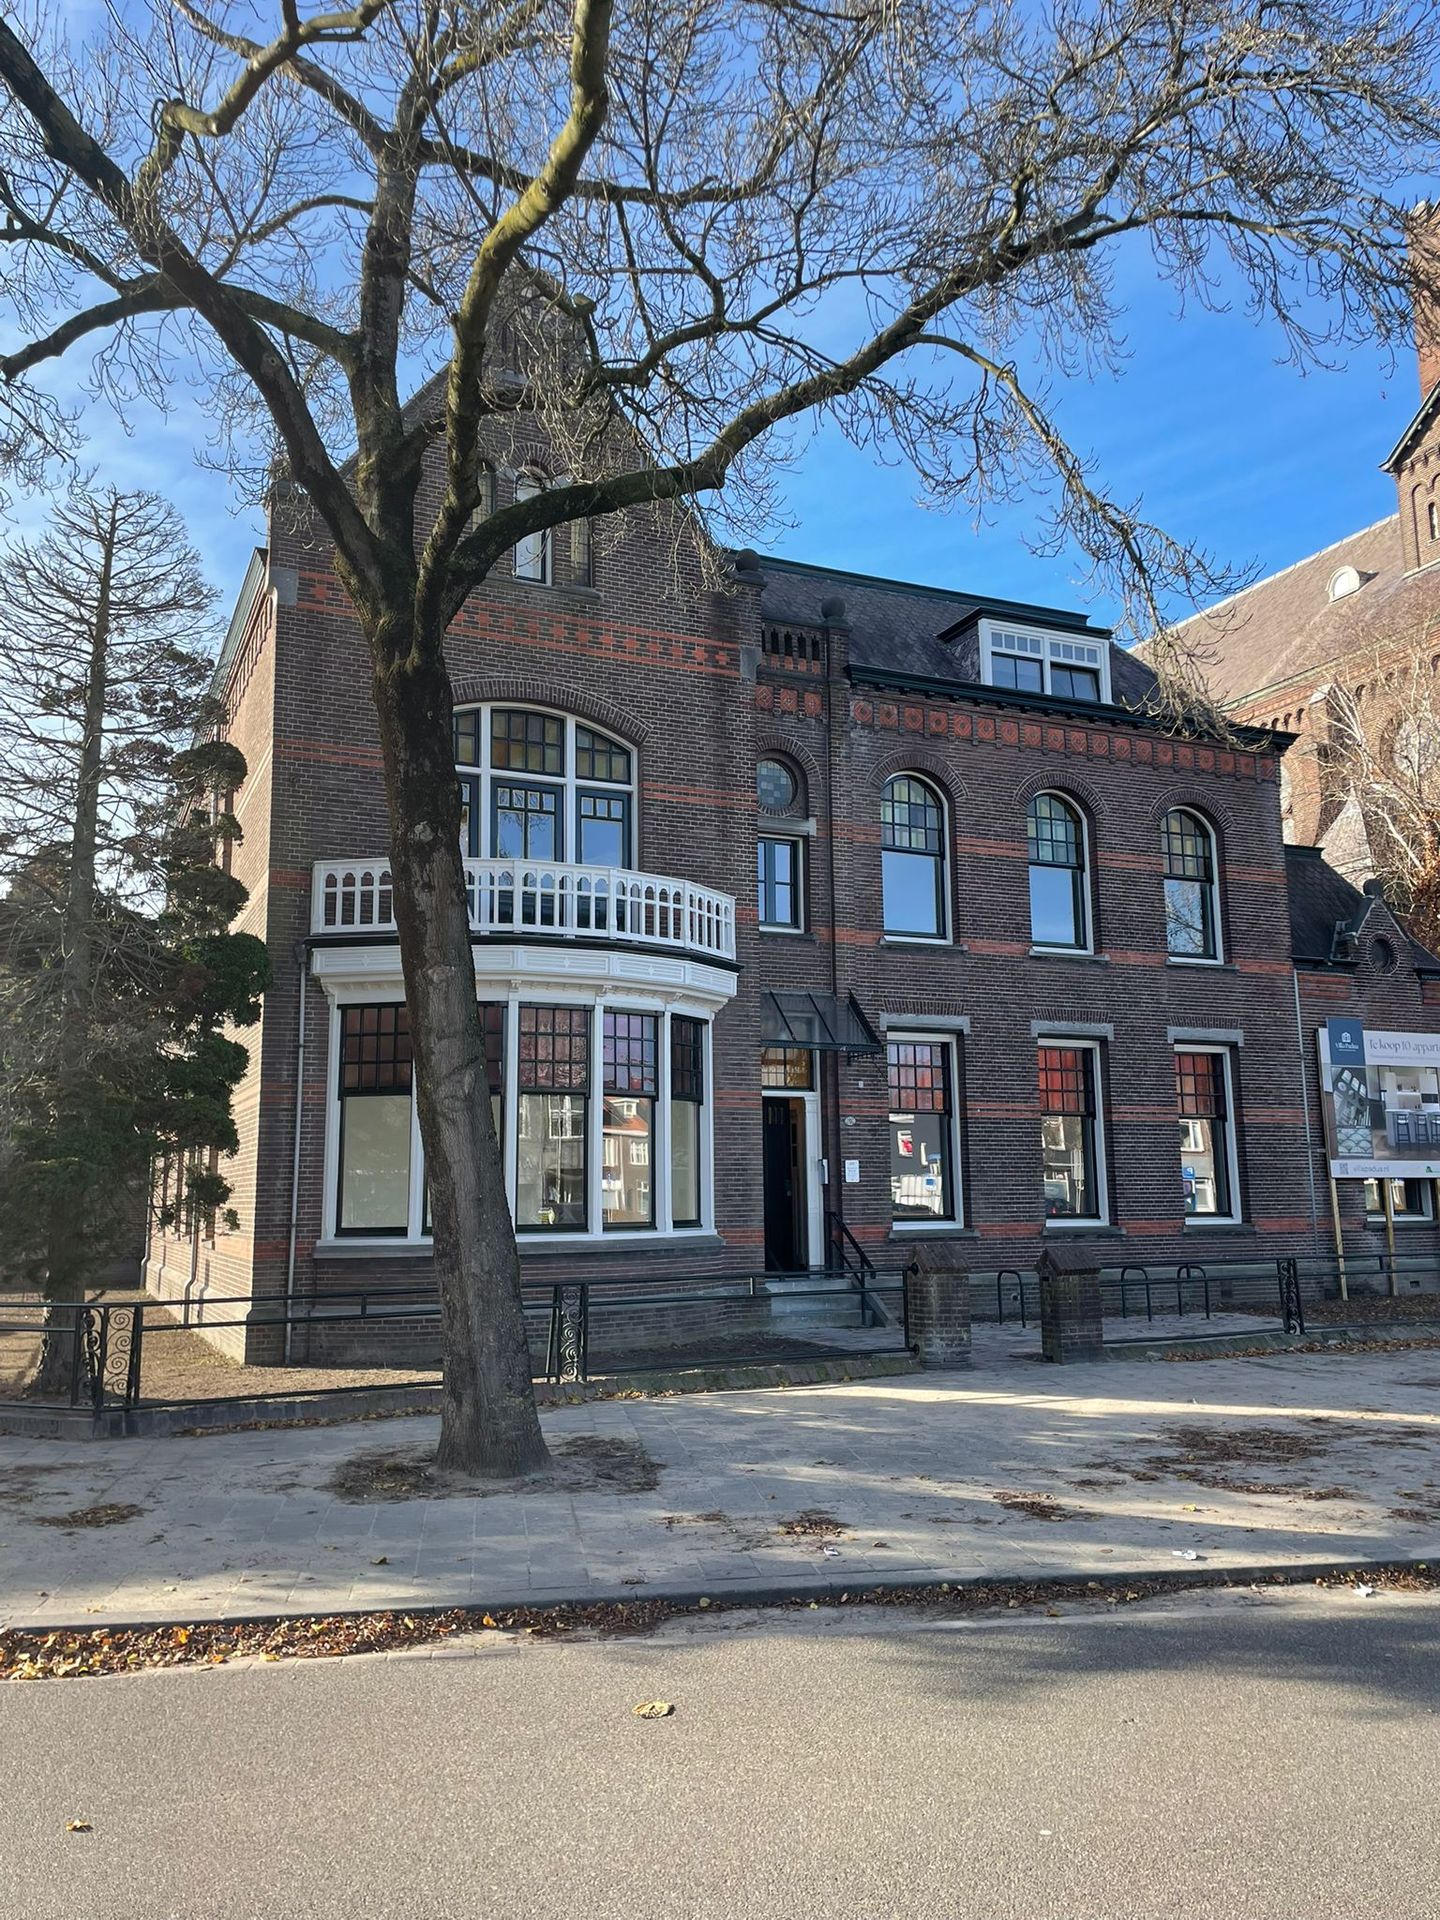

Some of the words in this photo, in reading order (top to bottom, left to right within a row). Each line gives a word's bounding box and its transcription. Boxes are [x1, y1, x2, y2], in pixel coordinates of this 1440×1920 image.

[1368, 1039, 1378, 1050] Te
[1379, 1039, 1401, 1053] koop
[1402, 1040, 1411, 1051] 10
[1413, 1043, 1440, 1055] appart
